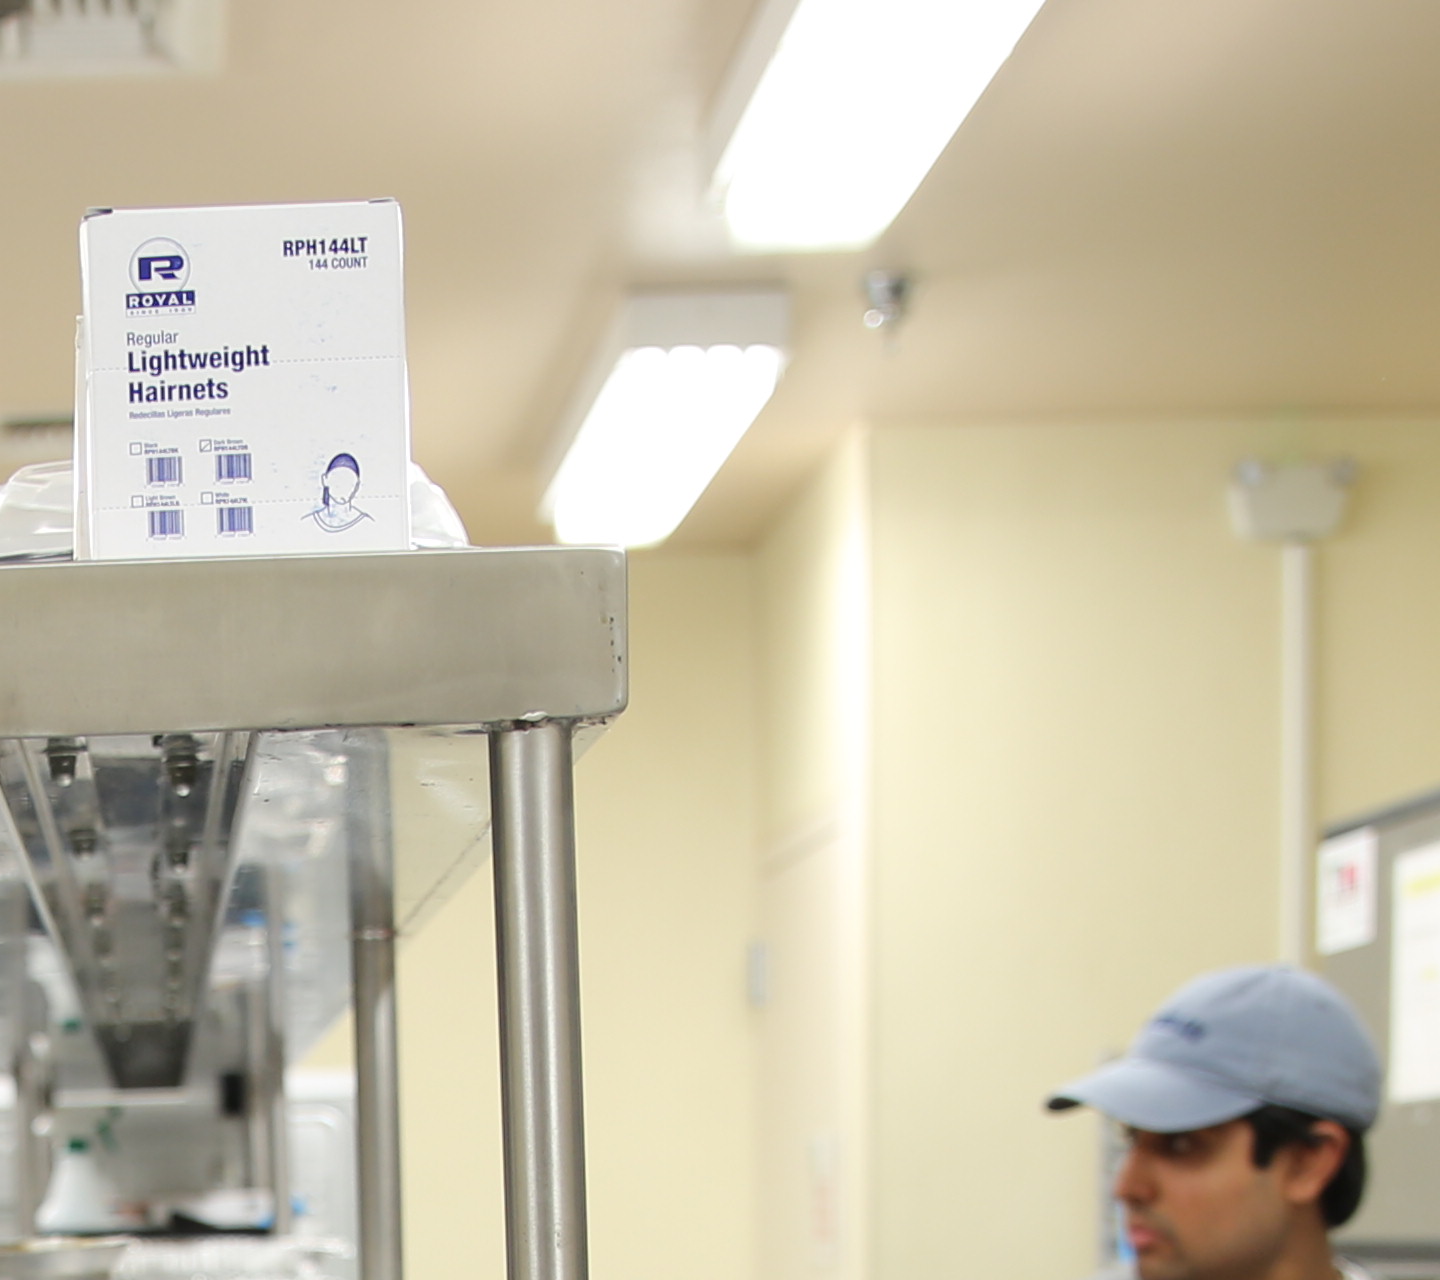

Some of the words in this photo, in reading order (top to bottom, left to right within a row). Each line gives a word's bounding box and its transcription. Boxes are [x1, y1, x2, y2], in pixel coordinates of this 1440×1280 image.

[283, 236, 368, 257] RPH144LT
[309, 258, 328, 270] 144
[331, 256, 368, 269] COUNT
[129, 293, 193, 308] ROYAL
[126, 330, 179, 348] Regular
[127, 345, 270, 377] Lightweight
[128, 378, 229, 404] Hairnets
